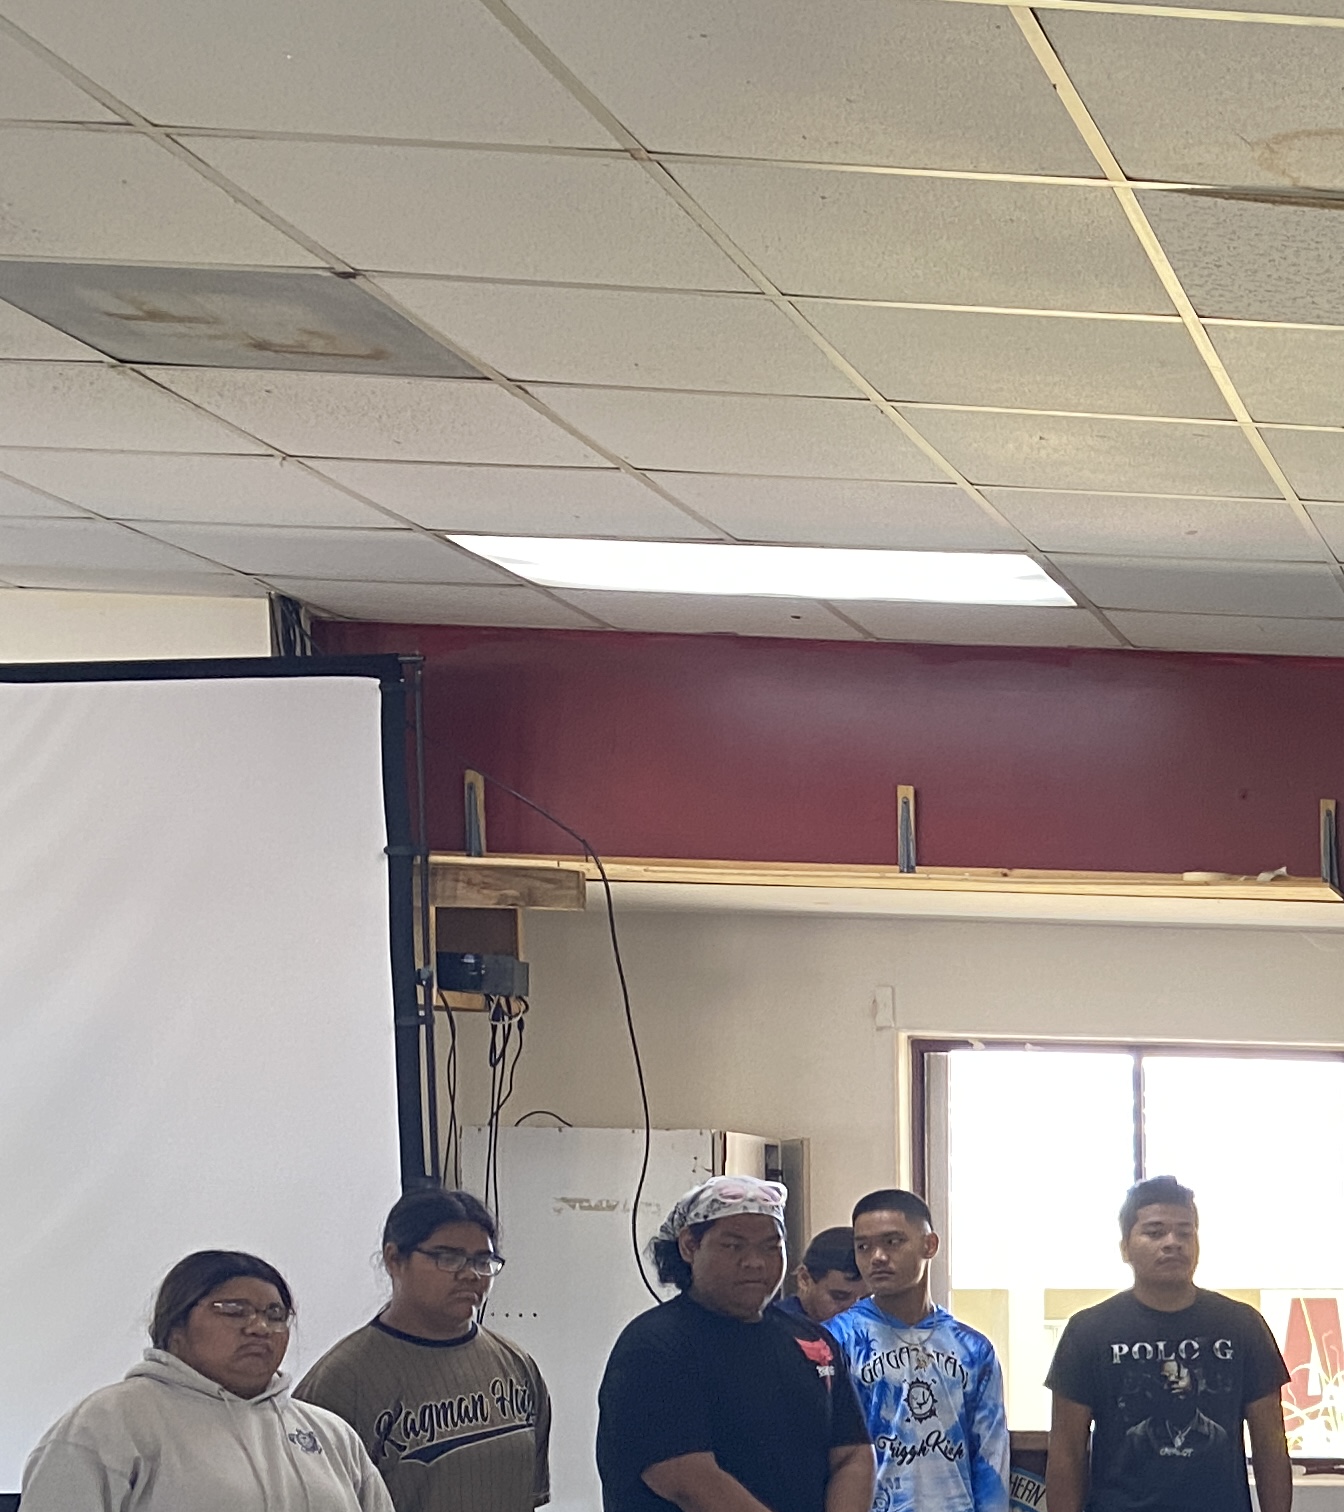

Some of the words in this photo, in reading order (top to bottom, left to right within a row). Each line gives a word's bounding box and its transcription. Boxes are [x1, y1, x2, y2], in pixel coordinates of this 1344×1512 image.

[1111, 1339, 1200, 1364] POLO
[1213, 1339, 1234, 1360] G
[373, 1391, 490, 1458] Kagman
[489, 1376, 535, 1425] Hig
[1010, 1473, 1047, 1507] HERN
